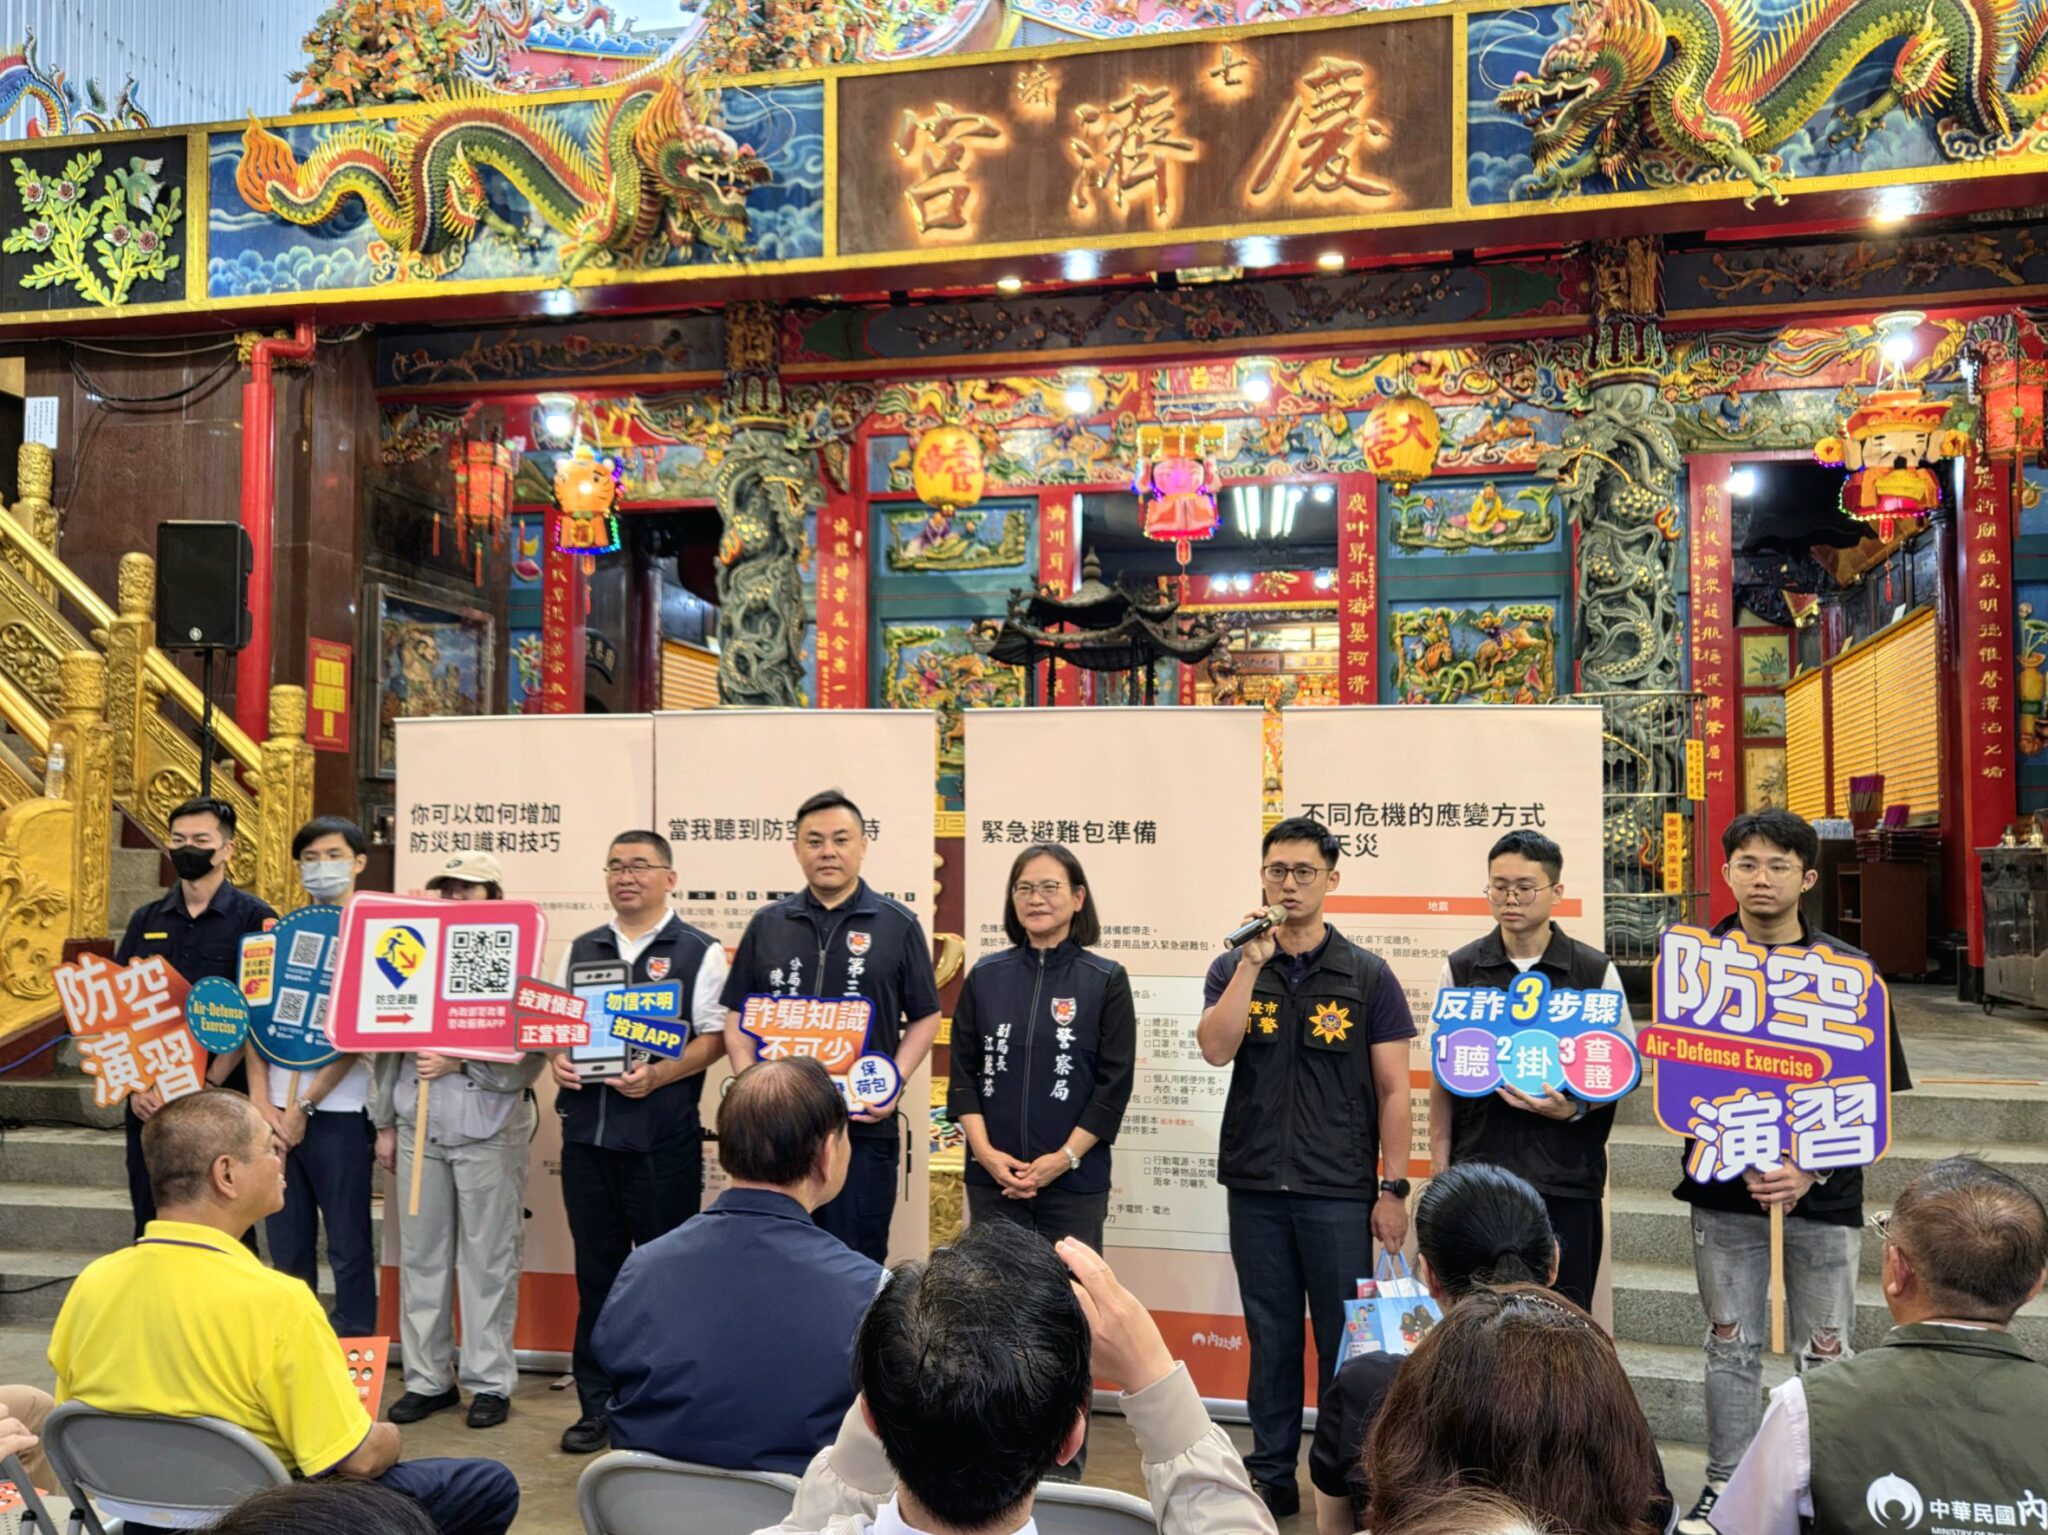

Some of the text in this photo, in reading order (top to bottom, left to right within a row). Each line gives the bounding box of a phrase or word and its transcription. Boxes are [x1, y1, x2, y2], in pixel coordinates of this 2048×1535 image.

[410, 803, 561, 825] 你可以如何增加
[1301, 802, 1546, 828] 不同危機的應變方式
[410, 831, 561, 853] 防災知識和技巧
[981, 819, 1157, 845] 緊急避難包準備
[1427, 901, 1449, 912] 地震
[54, 954, 182, 1034] 防空
[605, 992, 674, 1011] 勿信不明
[1436, 977, 1621, 1024] 反詐3步驟
[1663, 932, 1866, 1051] 防空
[192, 1002, 246, 1019] Air-Defense
[200, 1016, 236, 1034] Exercise
[742, 997, 871, 1033] 詐騙知識
[521, 1025, 588, 1044] 正當管道
[612, 1017, 681, 1049] 投資APP
[996, 1023, 1012, 1072] 副局長
[1436, 1035, 1449, 1060] 1
[757, 1035, 853, 1067] 不可少
[1453, 1045, 1490, 1078] 聽
[1496, 1035, 1513, 1061] 2
[1559, 1037, 1576, 1063] 3
[1646, 1033, 1813, 1079] Air-Defense Exercise
[78, 1030, 203, 1105] 演習
[1049, 1027, 1077, 1101] 警察局
[1516, 1046, 1553, 1080] 掛
[1583, 1037, 1613, 1090] 查證
[856, 1077, 888, 1095] 荷包
[1694, 1082, 1877, 1183] 演習
[1206, 1330, 1243, 1351] 內政部
[1929, 1498, 2017, 1527] 中華民國
